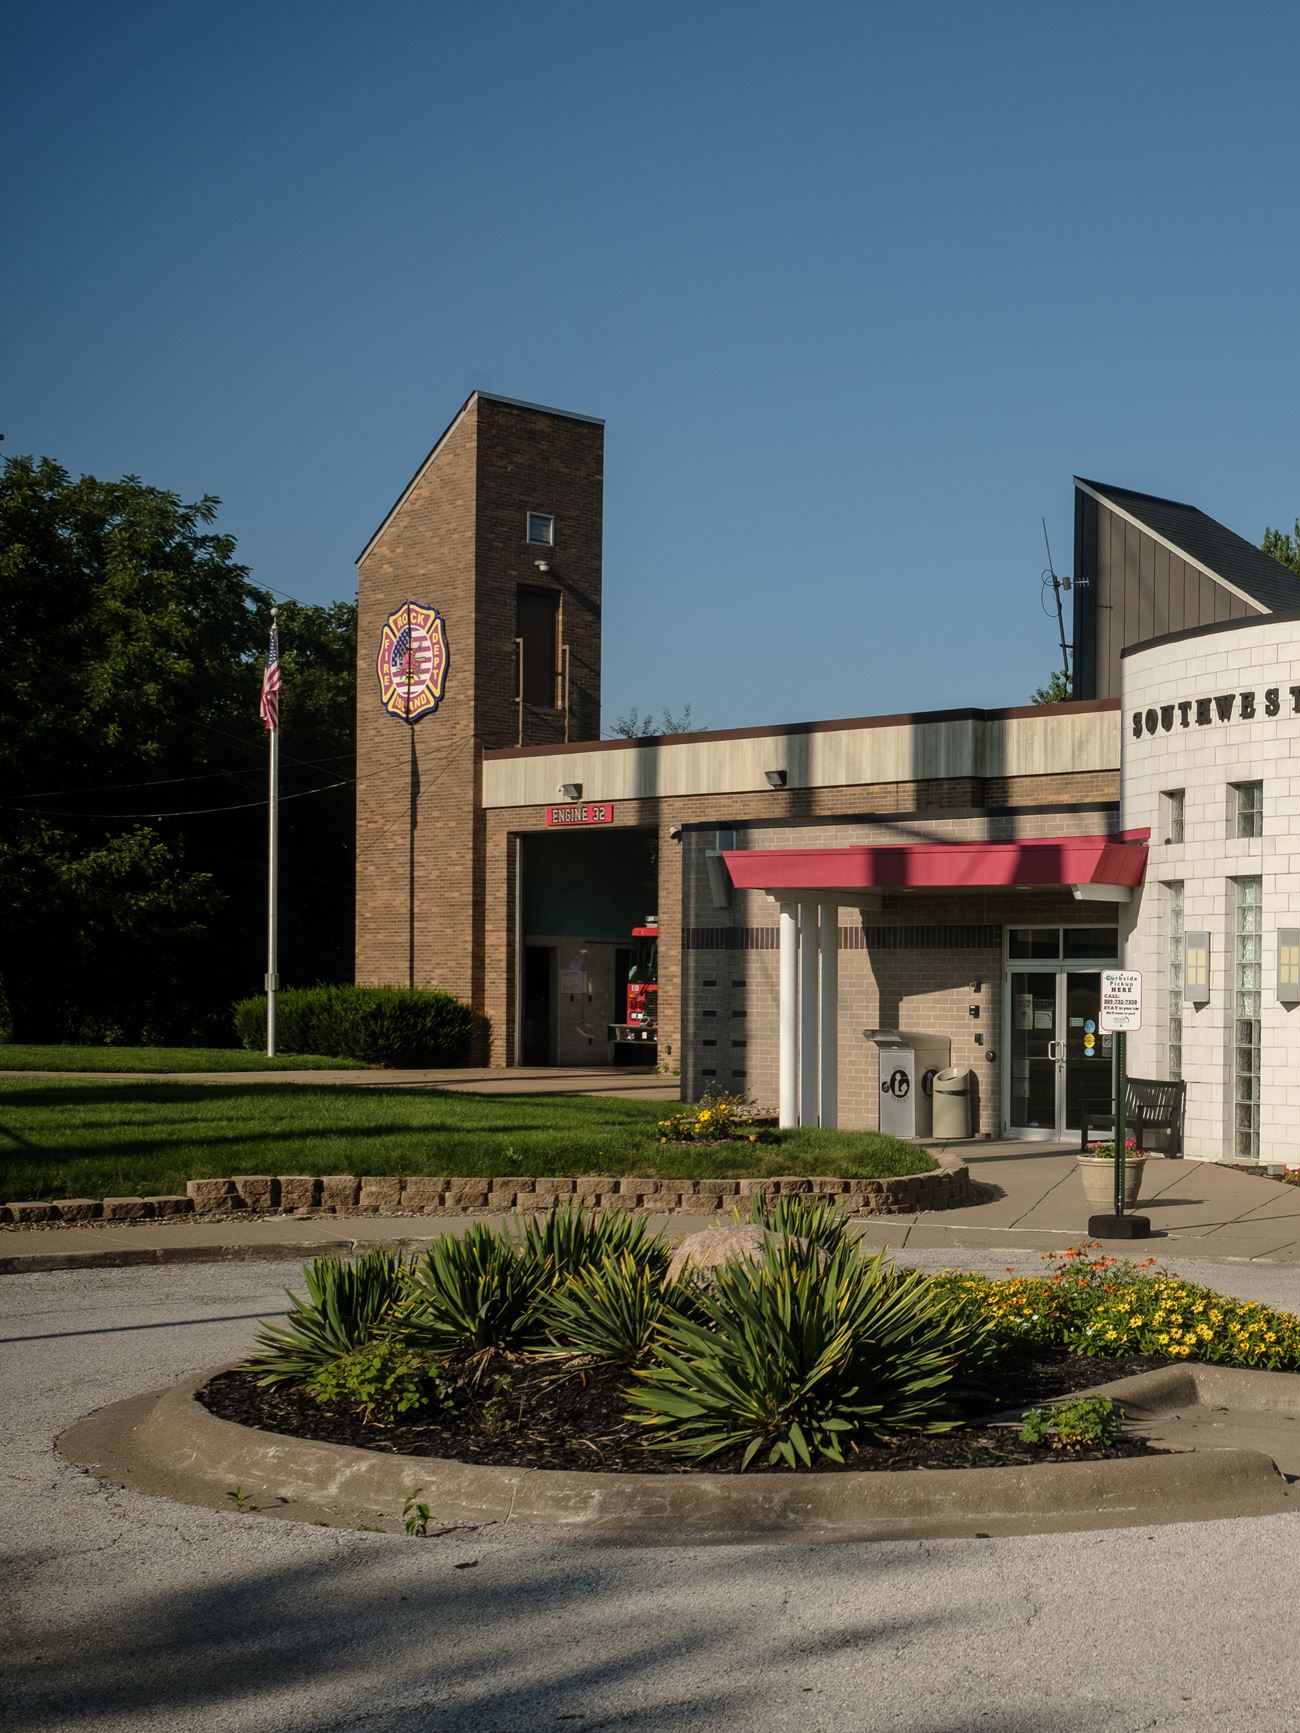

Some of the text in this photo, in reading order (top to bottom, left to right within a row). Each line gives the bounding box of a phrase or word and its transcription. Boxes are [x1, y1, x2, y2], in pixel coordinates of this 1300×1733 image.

[397, 612, 425, 627] ROCK
[432, 633, 440, 679] DEPT
[395, 696, 427, 711] ISLAND
[552, 807, 605, 823] ENGINE 32
